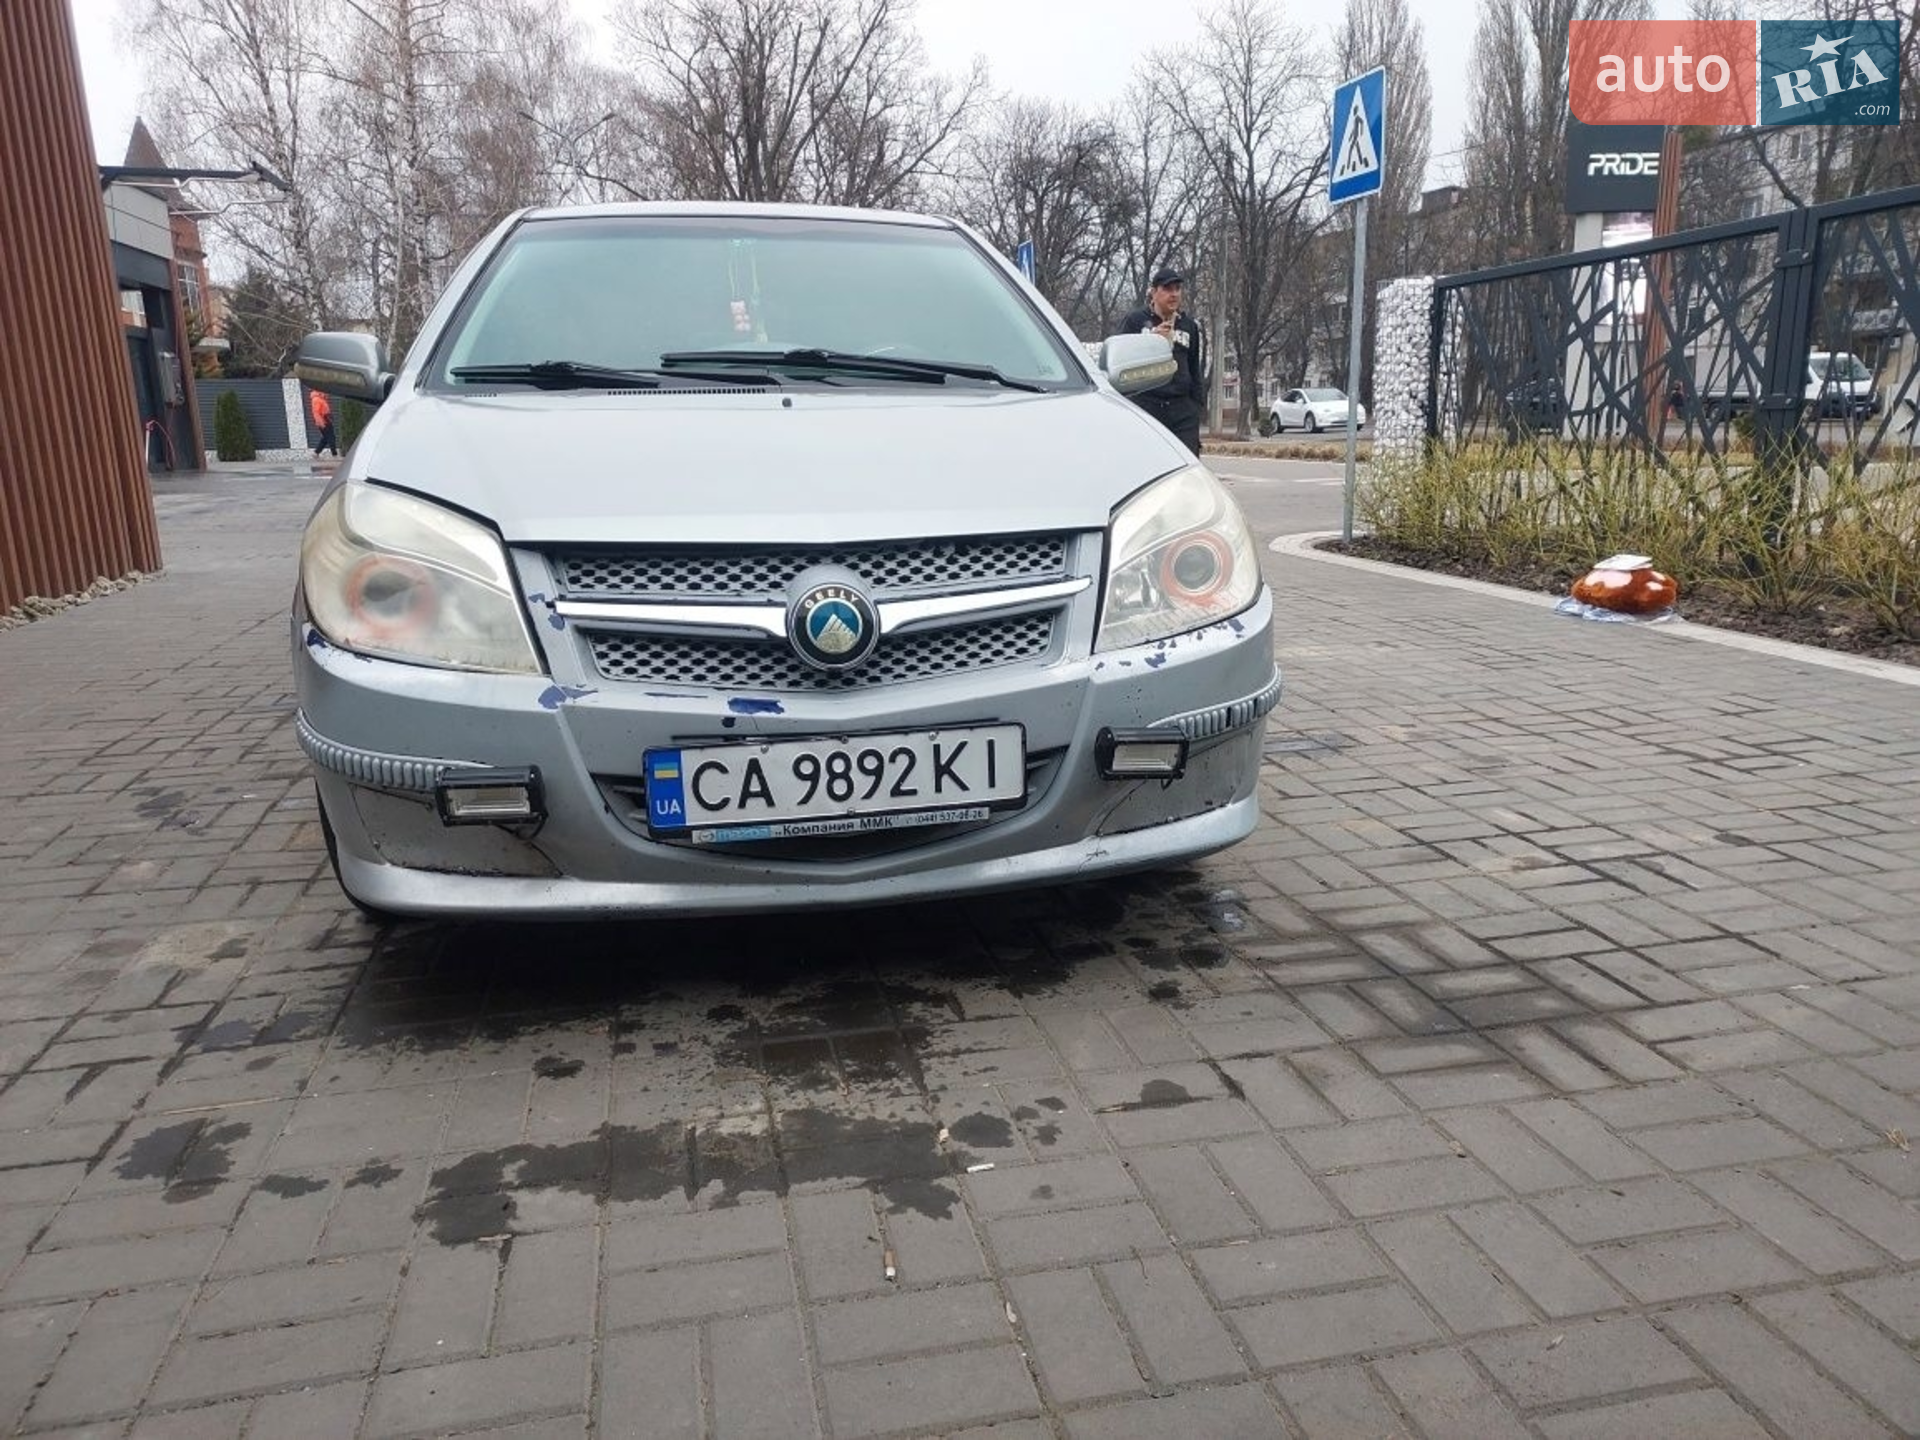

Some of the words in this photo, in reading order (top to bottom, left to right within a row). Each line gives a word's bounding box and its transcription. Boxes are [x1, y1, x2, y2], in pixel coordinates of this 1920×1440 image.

[804, 588, 859, 609] GEELY
[691, 757, 776, 812] CA
[791, 746, 918, 807] 9892
[932, 738, 996, 794] KI
[656, 798, 682, 815] UA
